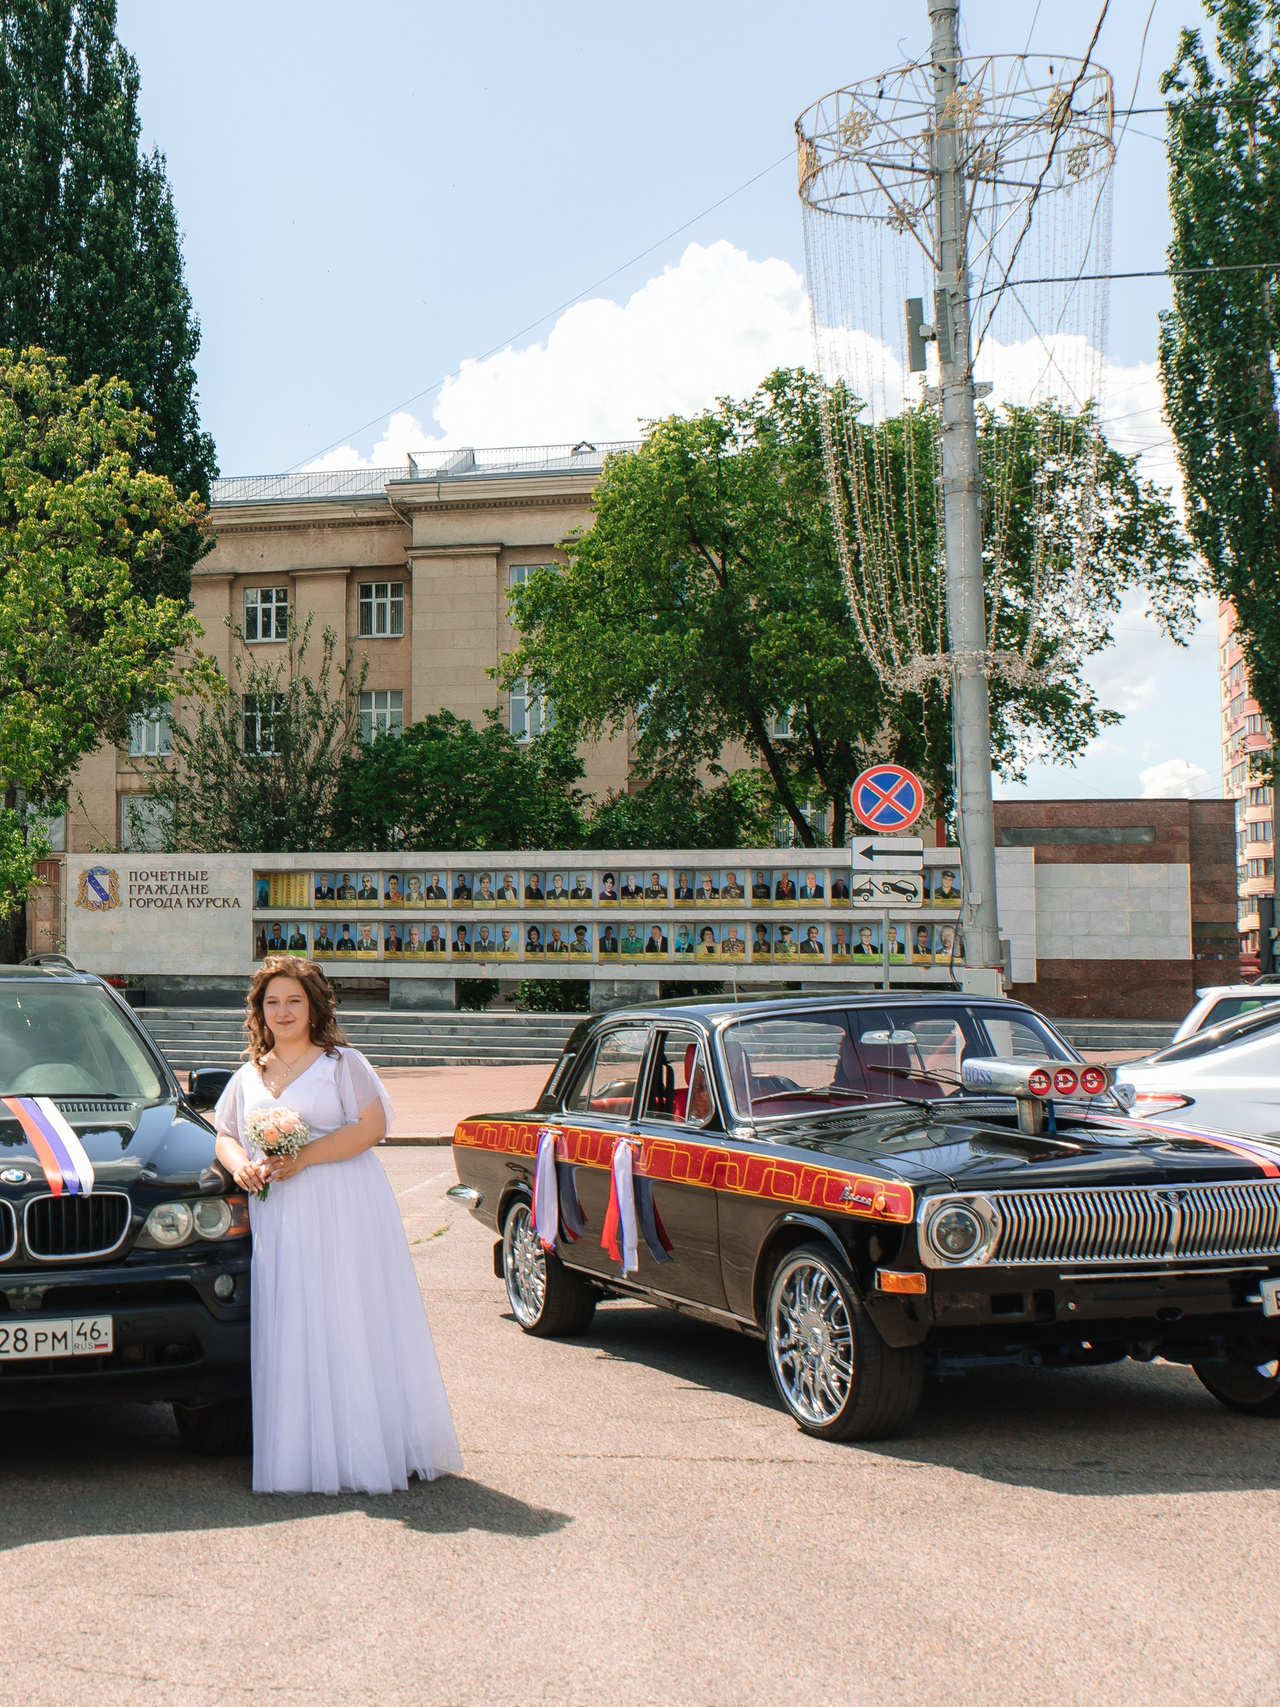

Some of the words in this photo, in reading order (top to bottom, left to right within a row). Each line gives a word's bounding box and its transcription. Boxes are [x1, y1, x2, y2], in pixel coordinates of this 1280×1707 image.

[128, 870, 209, 882] ПОЧЕТНЫЕ
[128, 884, 210, 896] ГРАЖДАНЕ
[128, 897, 184, 910] ГОРОДА
[186, 897, 242, 909] КУРСКА
[963, 1066, 993, 1086] BOSS
[75, 1320, 102, 1342] 46
[73, 1341, 95, 1351] RUS
